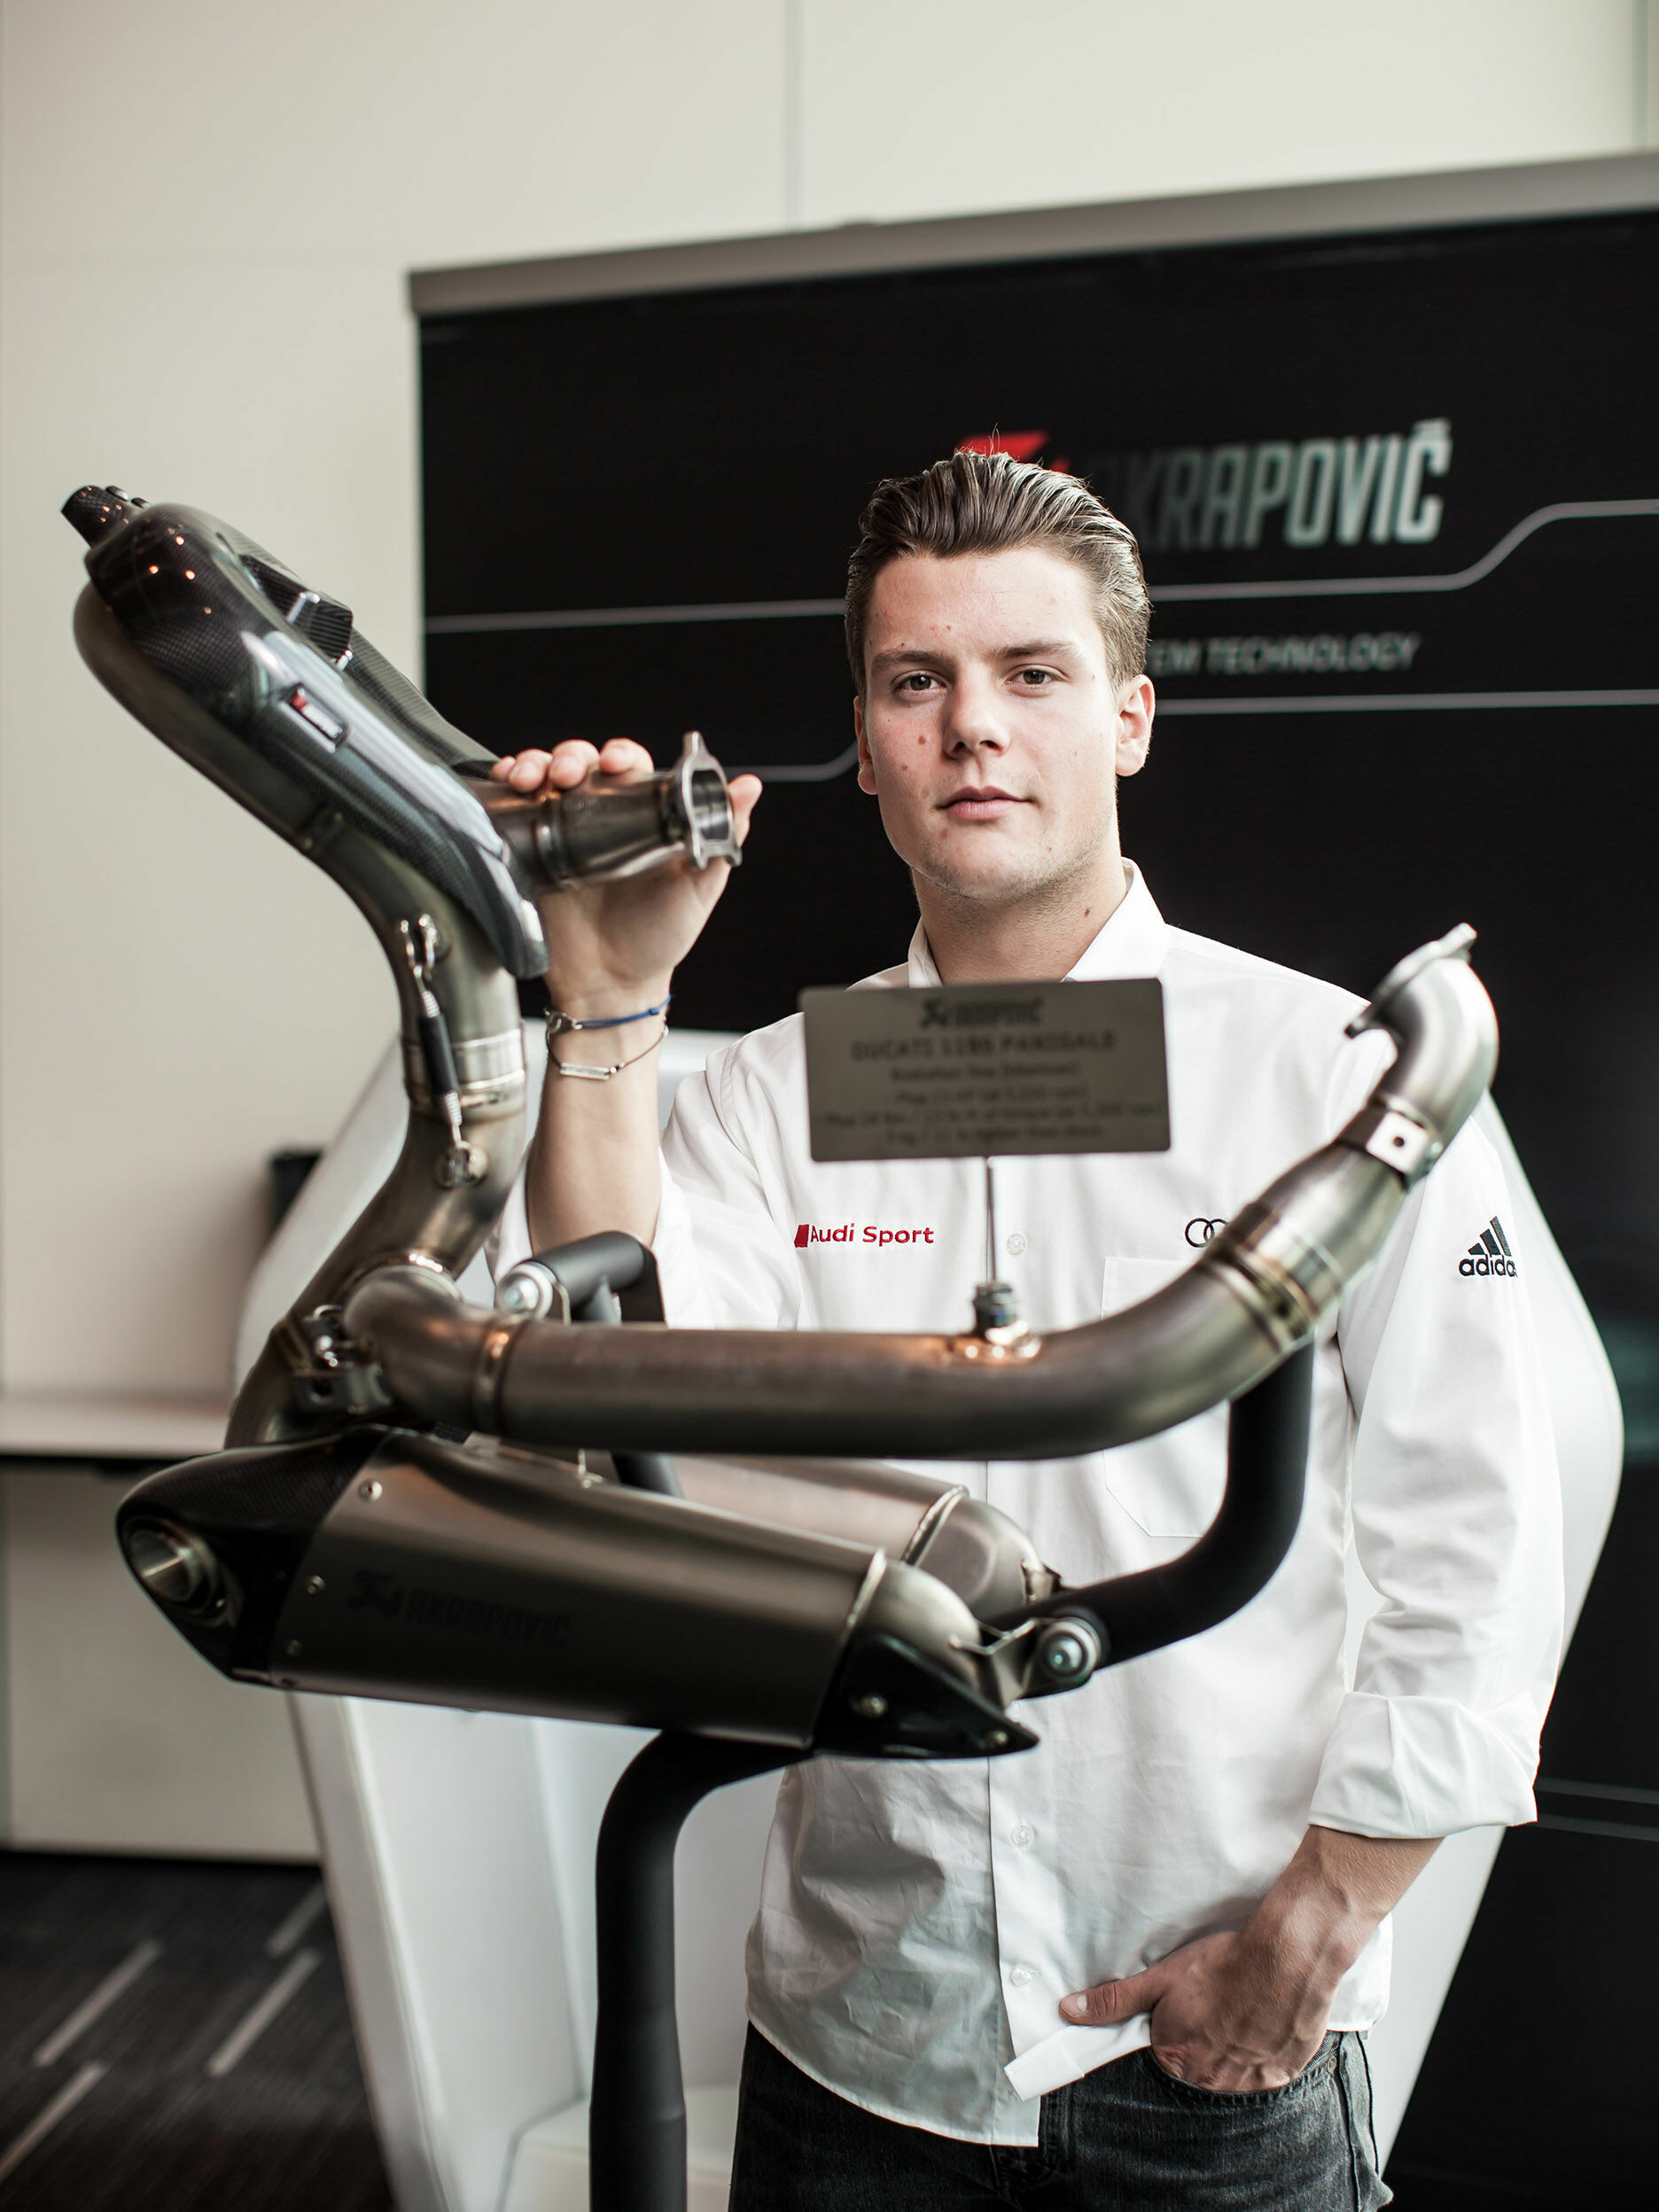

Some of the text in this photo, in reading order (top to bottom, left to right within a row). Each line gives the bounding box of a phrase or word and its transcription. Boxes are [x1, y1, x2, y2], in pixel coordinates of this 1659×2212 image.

[1206, 631, 1421, 675] TECHNOLOGY
[810, 1223, 934, 1247] Audi Sport
